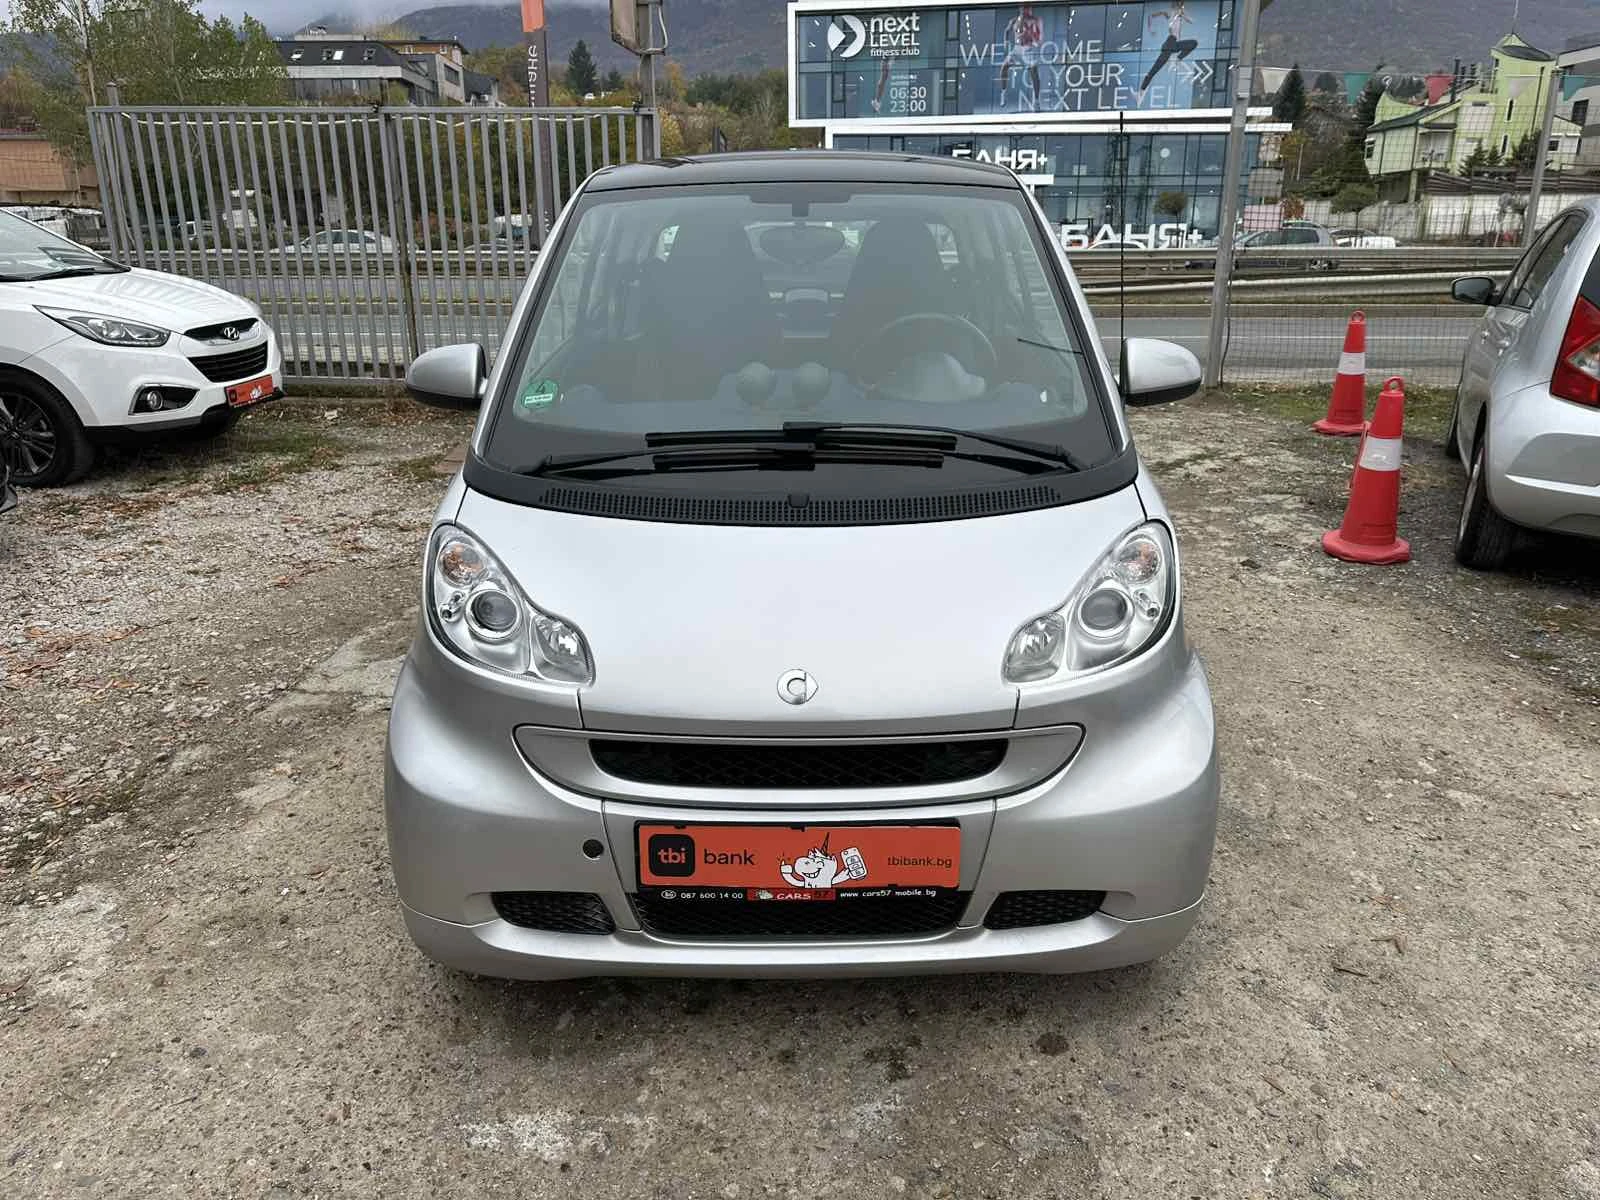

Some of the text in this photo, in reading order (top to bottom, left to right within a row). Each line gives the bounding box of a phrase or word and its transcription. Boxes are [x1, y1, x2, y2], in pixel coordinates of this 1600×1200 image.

[870, 12, 920, 33] next
[870, 32, 920, 47] LEVEL
[870, 46, 920, 58] fitness club
[1049, 63, 1123, 88] YOUR
[889, 86, 927, 99] 06:30
[1018, 85, 1180, 112] NEXT LEVEL
[889, 99, 927, 113] 23:00
[658, 847, 756, 866] tbi bank
[887, 855, 953, 869] tbibank.bg
